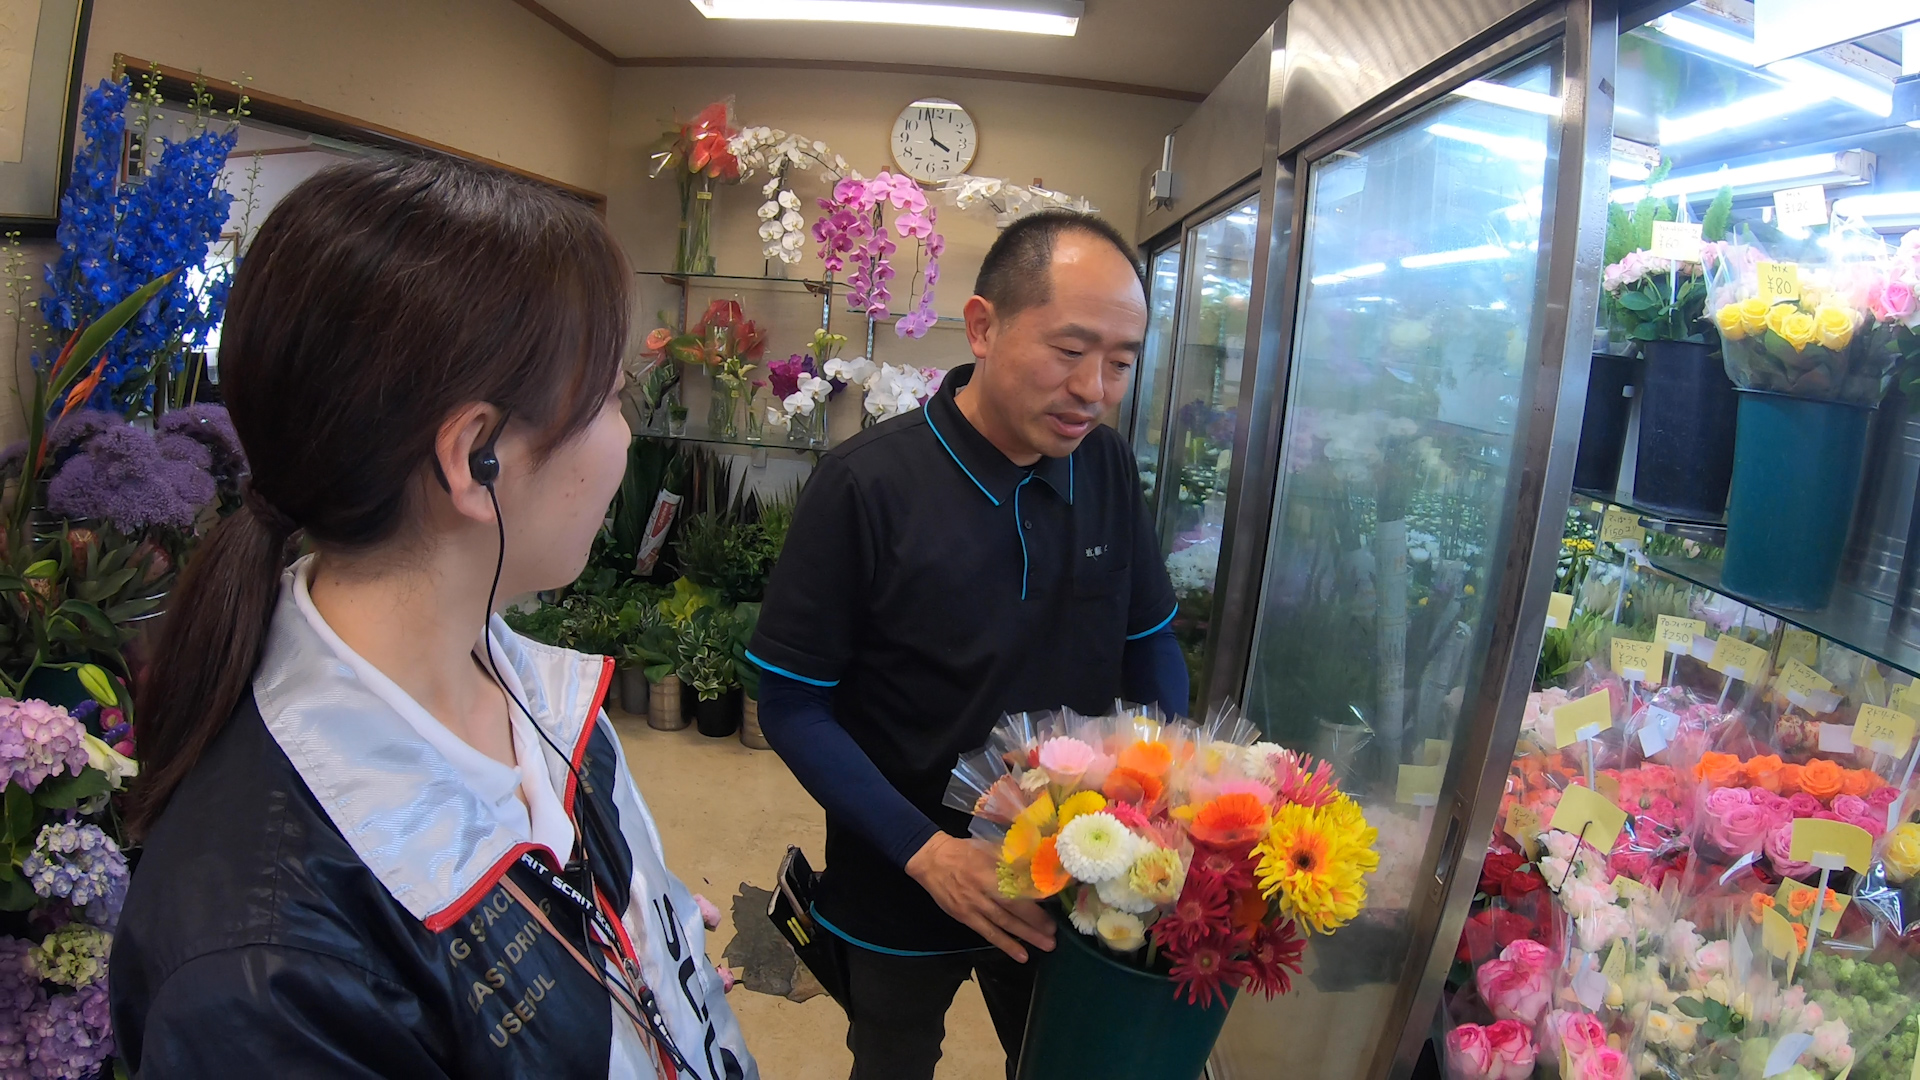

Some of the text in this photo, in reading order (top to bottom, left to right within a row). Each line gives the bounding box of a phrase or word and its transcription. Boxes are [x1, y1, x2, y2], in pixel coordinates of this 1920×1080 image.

[932, 108, 945, 120] 12
[905, 119, 919, 131] 10
[956, 122, 964, 135] 2
[900, 132, 909, 143] 9
[958, 138, 967, 149] 3
[903, 146, 913, 158] 8
[914, 157, 923, 169] 7
[926, 162, 935, 174] 6
[941, 160, 950, 171] 5
[1771, 264, 1789, 273] MIX
[1767, 274, 1792, 295] ¥80
[1662, 629, 1689, 644] ¥250
[1618, 652, 1648, 668] ¥250
[1720, 648, 1747, 666] ¥250
[1786, 673, 1812, 698] ¥250
[1863, 718, 1895, 739] ¥250
[551, 875, 594, 910] SCRIT
